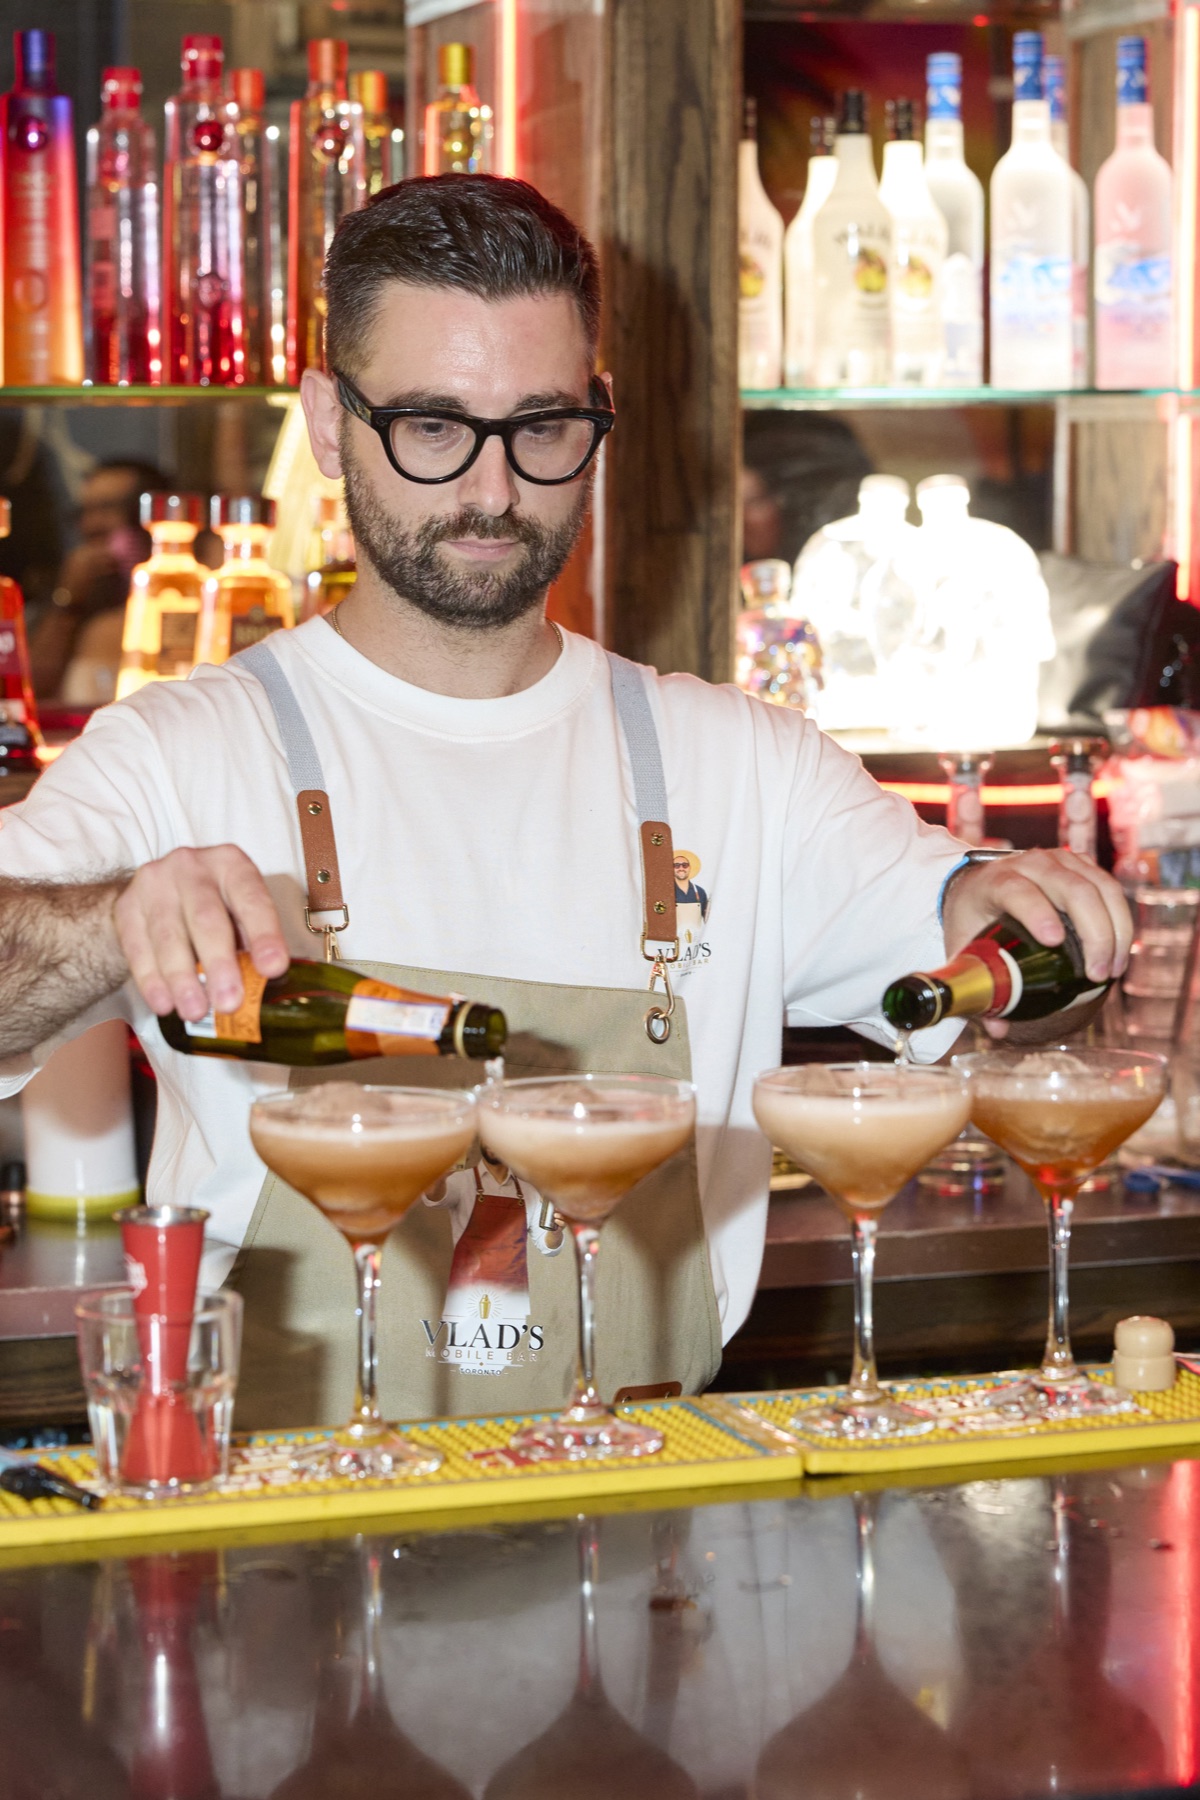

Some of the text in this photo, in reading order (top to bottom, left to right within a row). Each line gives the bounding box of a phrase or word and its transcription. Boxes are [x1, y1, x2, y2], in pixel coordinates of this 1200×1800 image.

[420, 1319, 544, 1350] VLAD'S
[426, 1347, 538, 1362] MOBILE BAR
[460, 1367, 502, 1376] TORONTO
